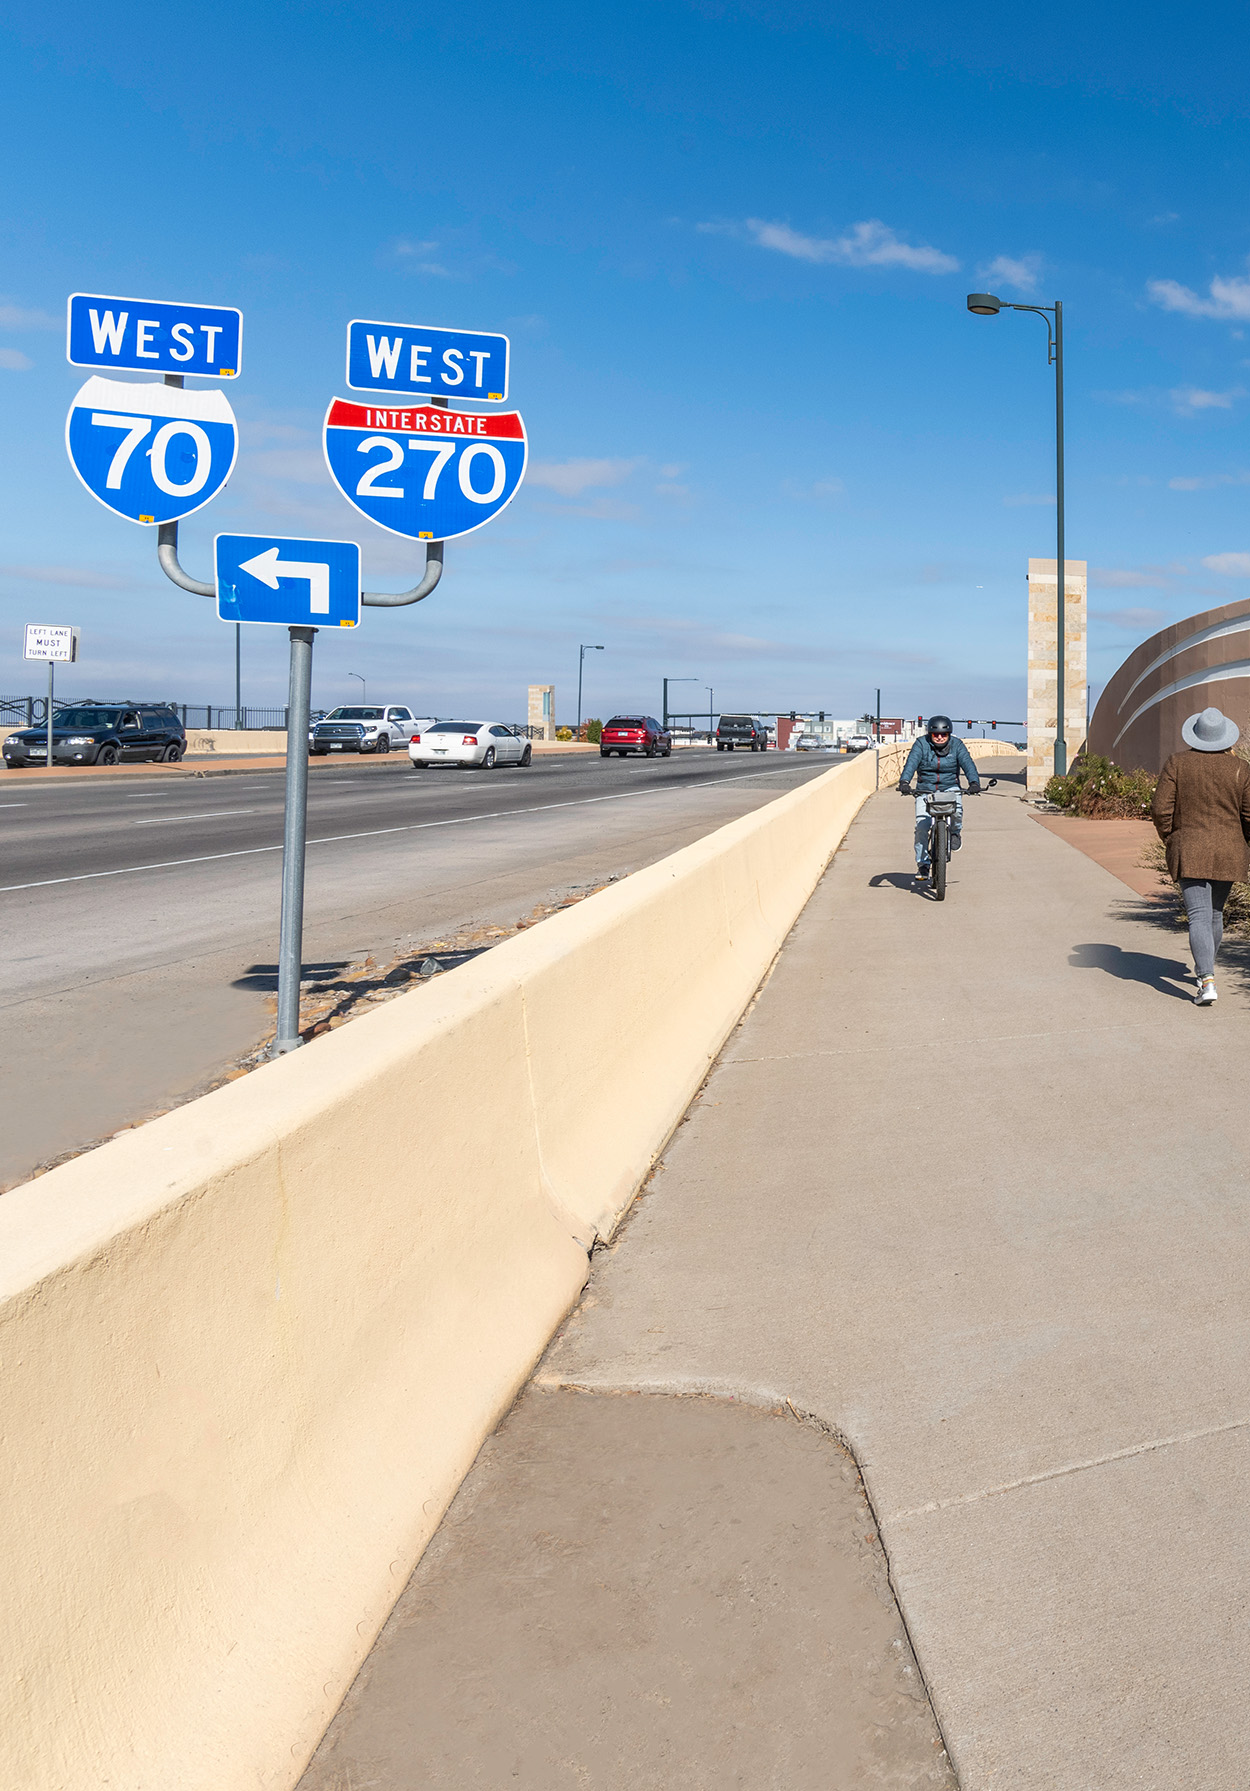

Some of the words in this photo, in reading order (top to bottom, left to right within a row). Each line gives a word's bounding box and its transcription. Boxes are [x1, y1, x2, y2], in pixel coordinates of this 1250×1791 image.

[88, 308, 223, 363] WEST
[366, 334, 491, 388] WEST
[366, 409, 487, 435] INTERSTATE
[91, 412, 212, 498] 70
[356, 435, 506, 505] 270
[36, 639, 60, 647] MUST
